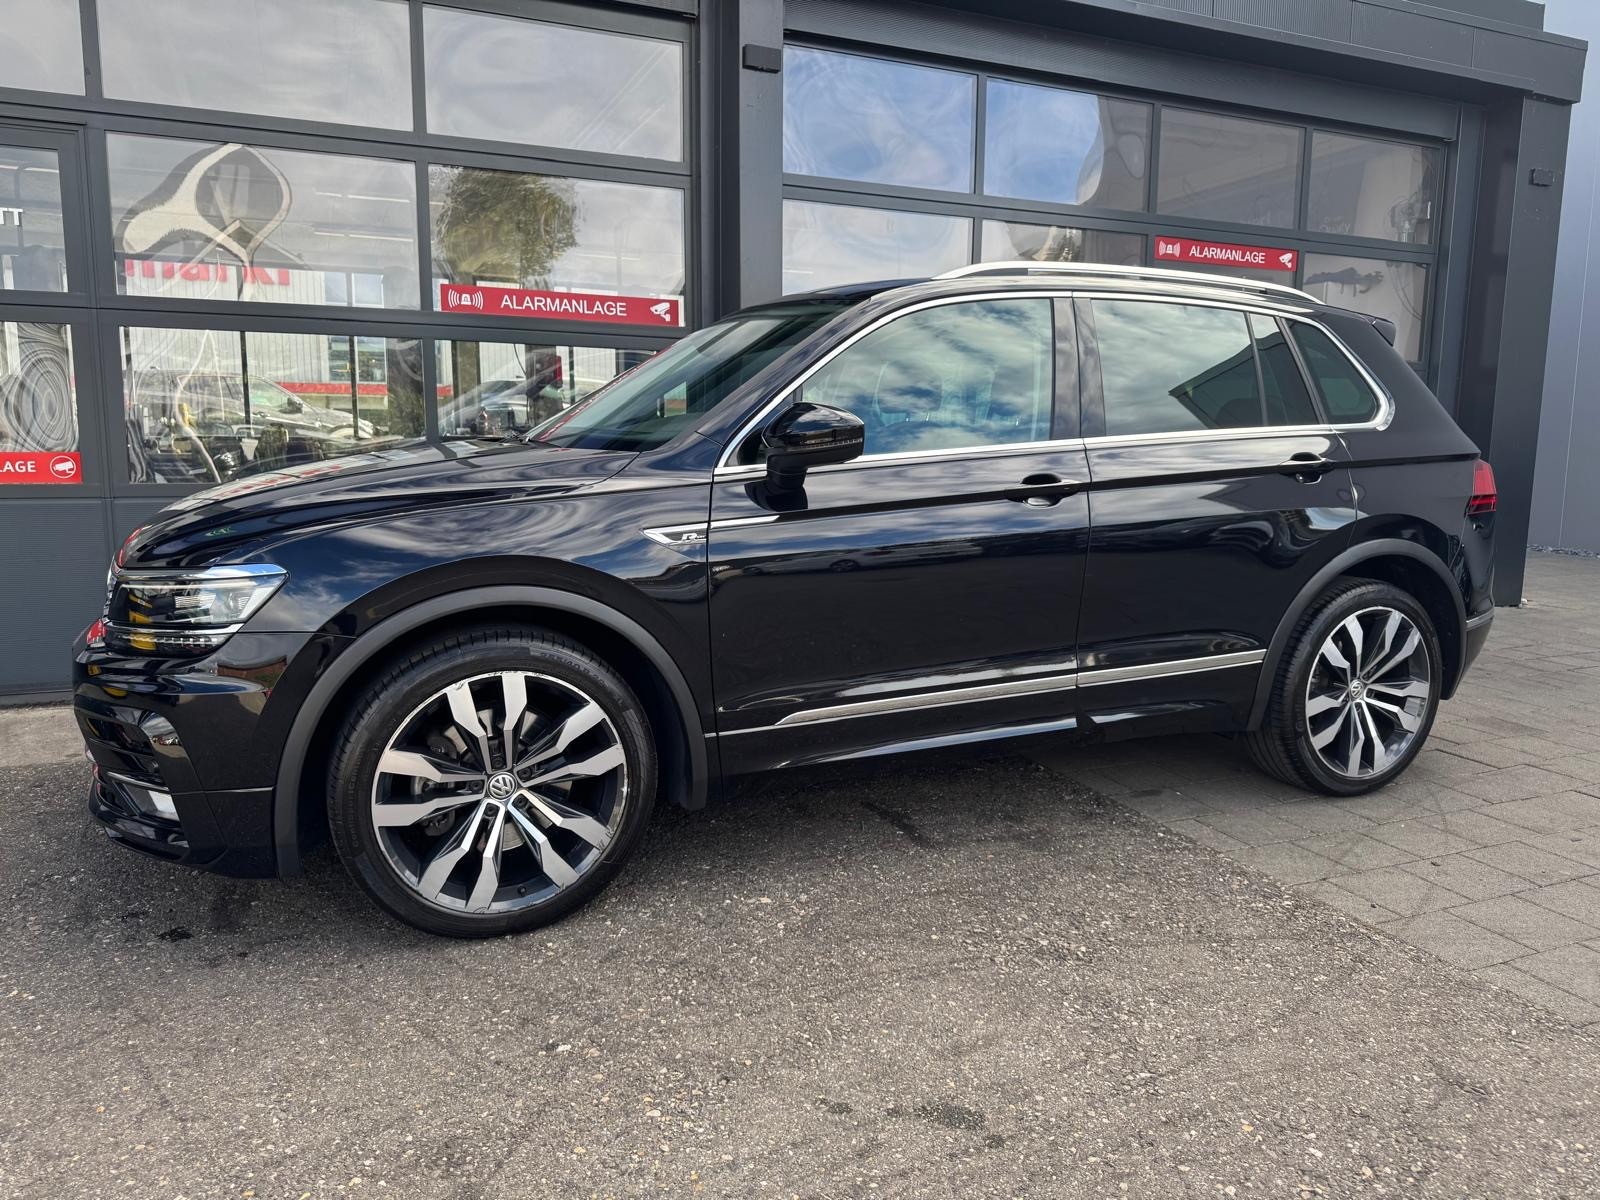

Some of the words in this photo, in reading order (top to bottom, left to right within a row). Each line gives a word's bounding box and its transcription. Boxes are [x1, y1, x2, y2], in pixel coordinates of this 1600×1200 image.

[1189, 245, 1266, 263] ALARMANLAGE
[500, 295, 627, 316] ALARMANLAGE
[0, 461, 36, 473] AGE
